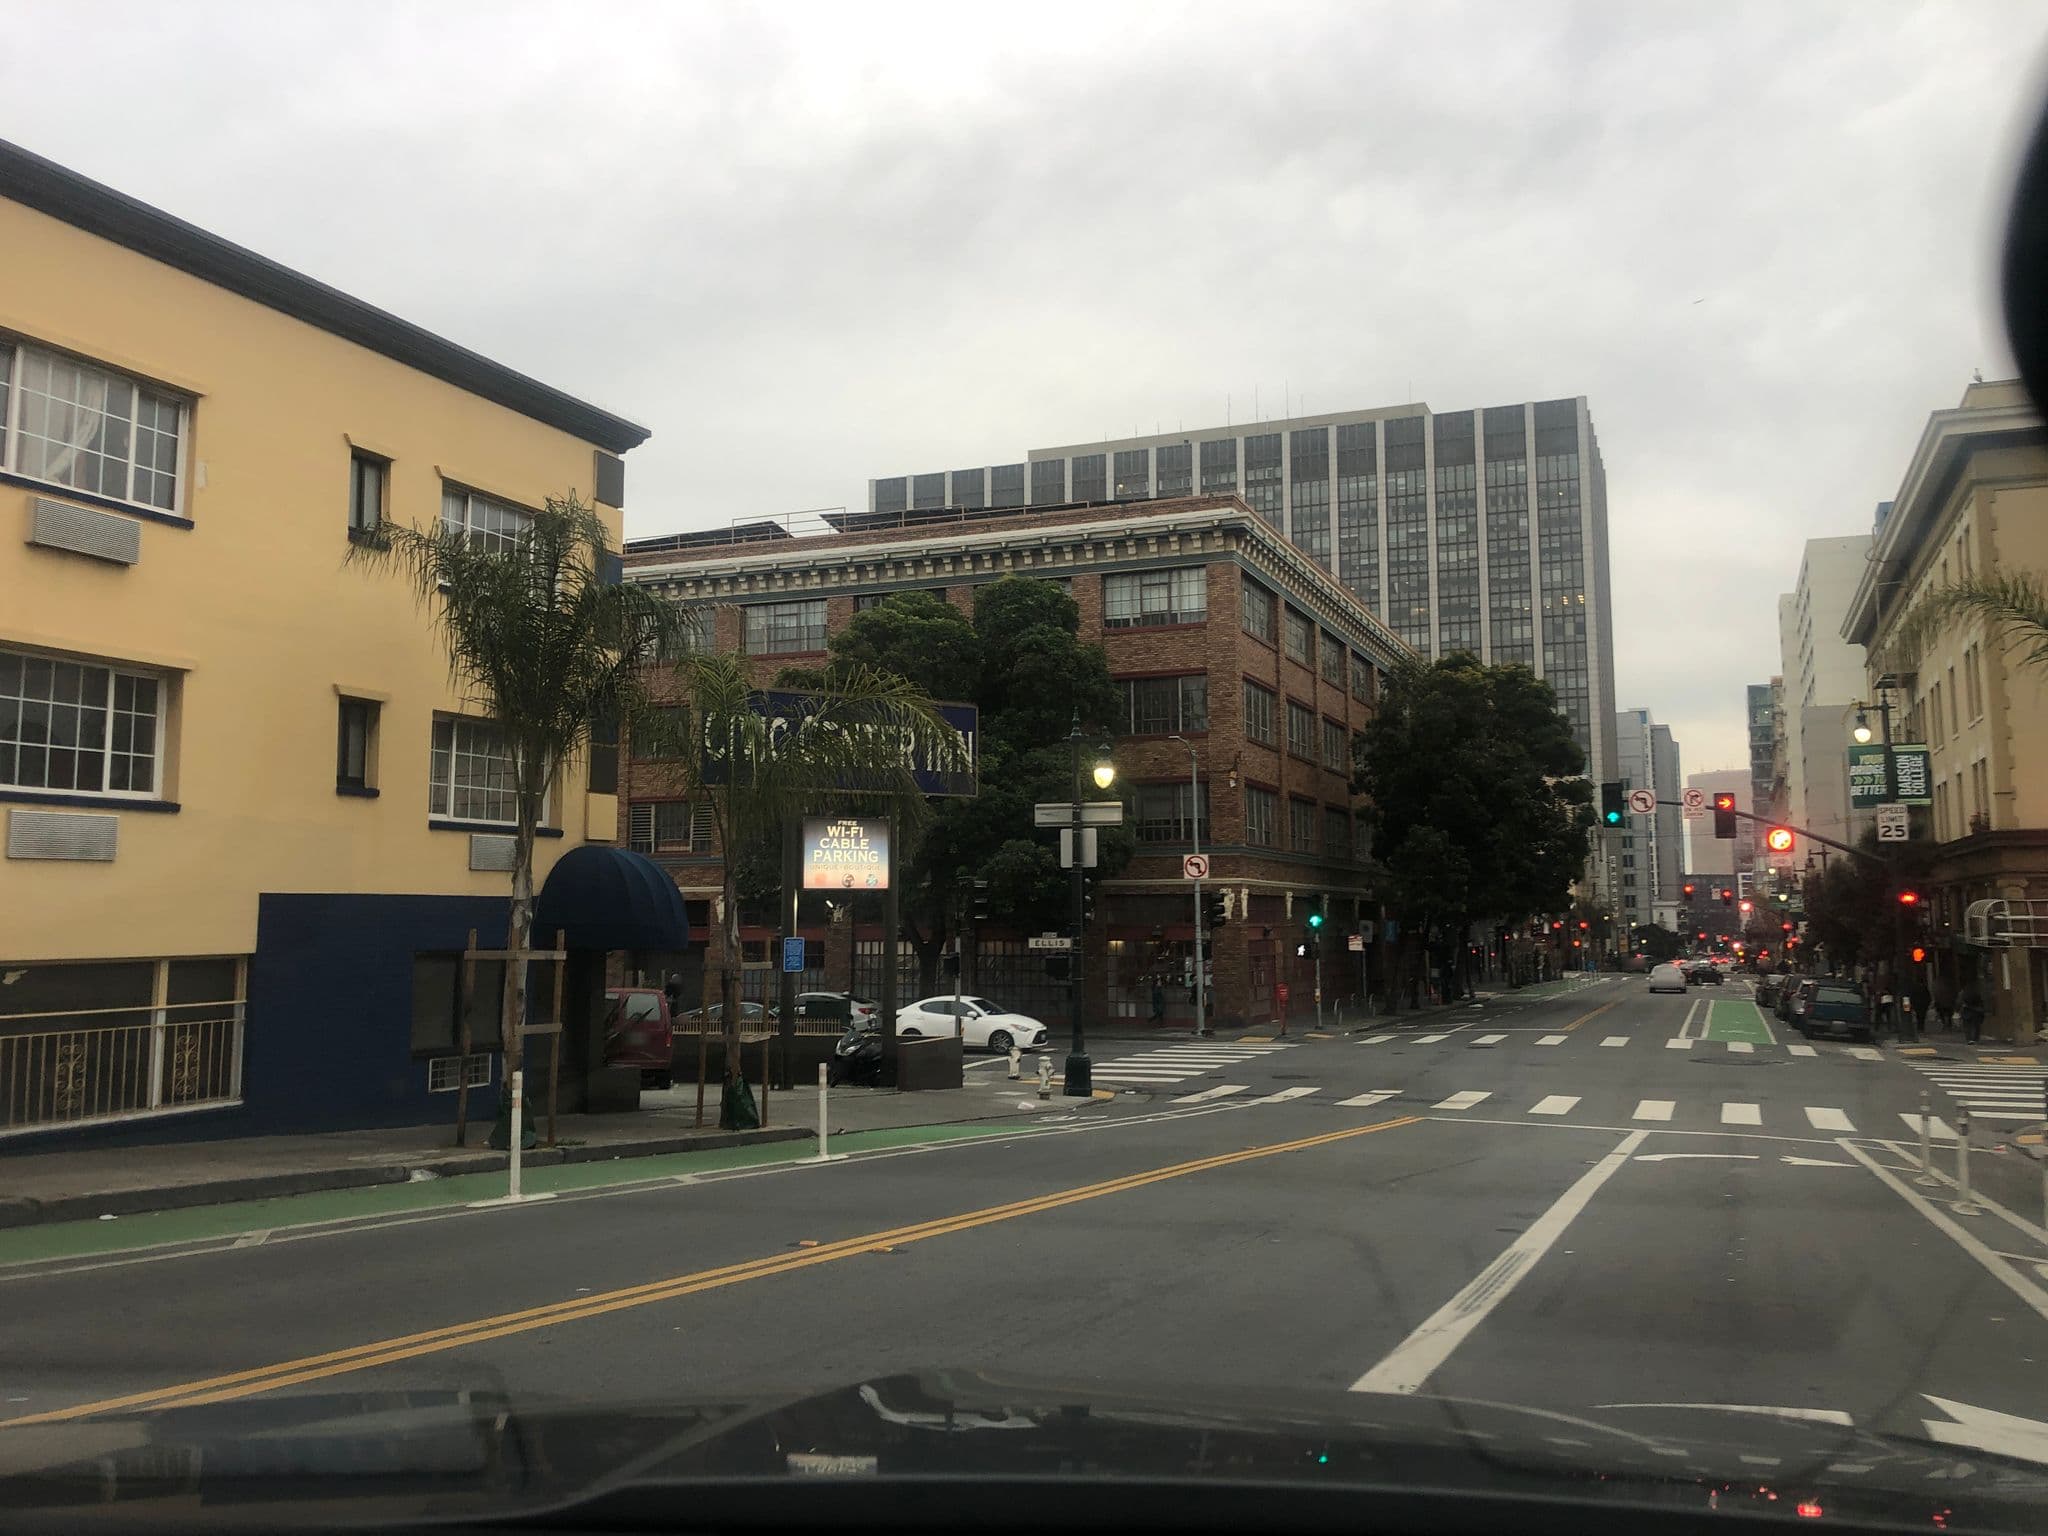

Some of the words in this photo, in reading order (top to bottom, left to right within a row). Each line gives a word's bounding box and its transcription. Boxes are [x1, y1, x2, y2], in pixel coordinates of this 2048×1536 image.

[1896, 754, 1912, 795] BABSON
[1911, 753, 1926, 796] COLLEGE
[827, 825, 864, 838] WI-FI
[1881, 824, 1905, 838] 25
[819, 838, 870, 850] CABLE
[813, 849, 879, 863] PARKING
[1034, 939, 1066, 947] ELLIS
